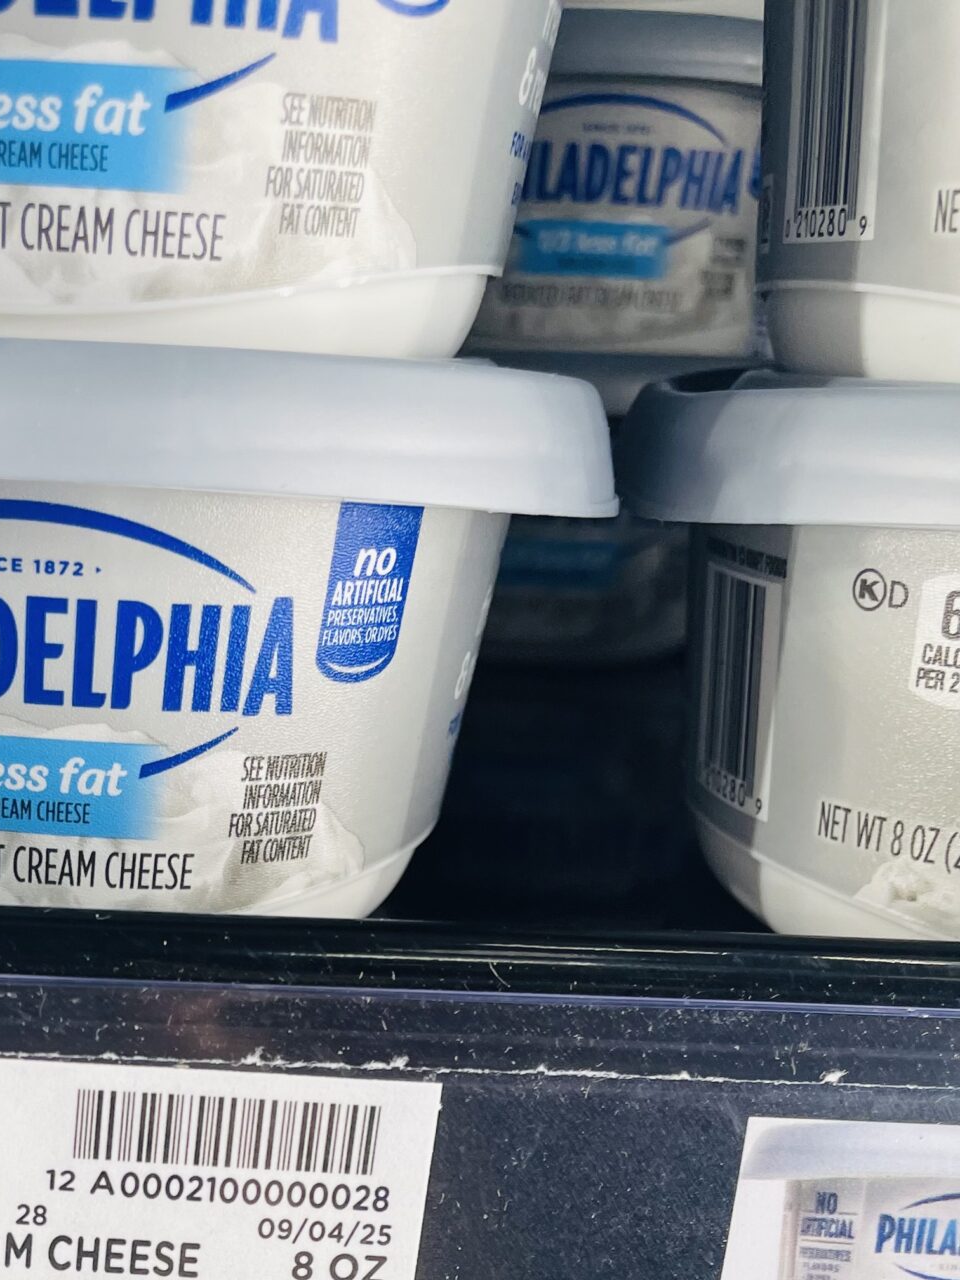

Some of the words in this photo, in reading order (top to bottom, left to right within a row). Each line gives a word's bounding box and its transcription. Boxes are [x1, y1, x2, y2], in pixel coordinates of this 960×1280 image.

[72, 82, 150, 138] fat
[280, 92, 307, 125] SEE
[307, 94, 377, 133] NUTRITION
[48, 142, 109, 173] CHEESE
[281, 129, 372, 169] INFORMATION
[265, 165, 293, 198] FOR
[294, 167, 365, 203] SATURATED
[21, 202, 115, 256] CREAM
[125, 208, 227, 262] CHEESE
[279, 203, 304, 235] FAT
[304, 205, 361, 238] CONTENT
[859, 216, 868, 236] 9
[34, 558, 85, 577] 1872
[353, 547, 397, 577] no
[331, 577, 404, 606] ARTIFICIAL
[365, 627, 378, 643] OR
[377, 625, 399, 643] DYES
[915, 667, 945, 690] PER
[55, 756, 127, 798] fat
[241, 756, 266, 782] SEE
[265, 751, 328, 781] NUTRITION
[243, 780, 322, 809] INFORMATION
[37, 800, 91, 825] CHEESE
[228, 812, 254, 838] FOR
[254, 808, 317, 837] SATURATED
[818, 800, 852, 843] NET
[857, 811, 888, 852] WT
[891, 820, 905, 856] 8
[910, 824, 941, 865] OZ
[241, 839, 263, 865] FAT
[263, 834, 313, 863] CONTENT
[12, 845, 96, 889] CREAM
[104, 852, 196, 892] CHEESE
[46, 1169, 76, 1191] 12
[90, 1170, 391, 1213] A0002100000028
[815, 1191, 839, 1215] NO
[15, 1204, 48, 1227] 28
[257, 1217, 393, 1248] 09/04/25
[48, 1234, 201, 1279] CHEESE
[291, 1250, 314, 1280] 8
